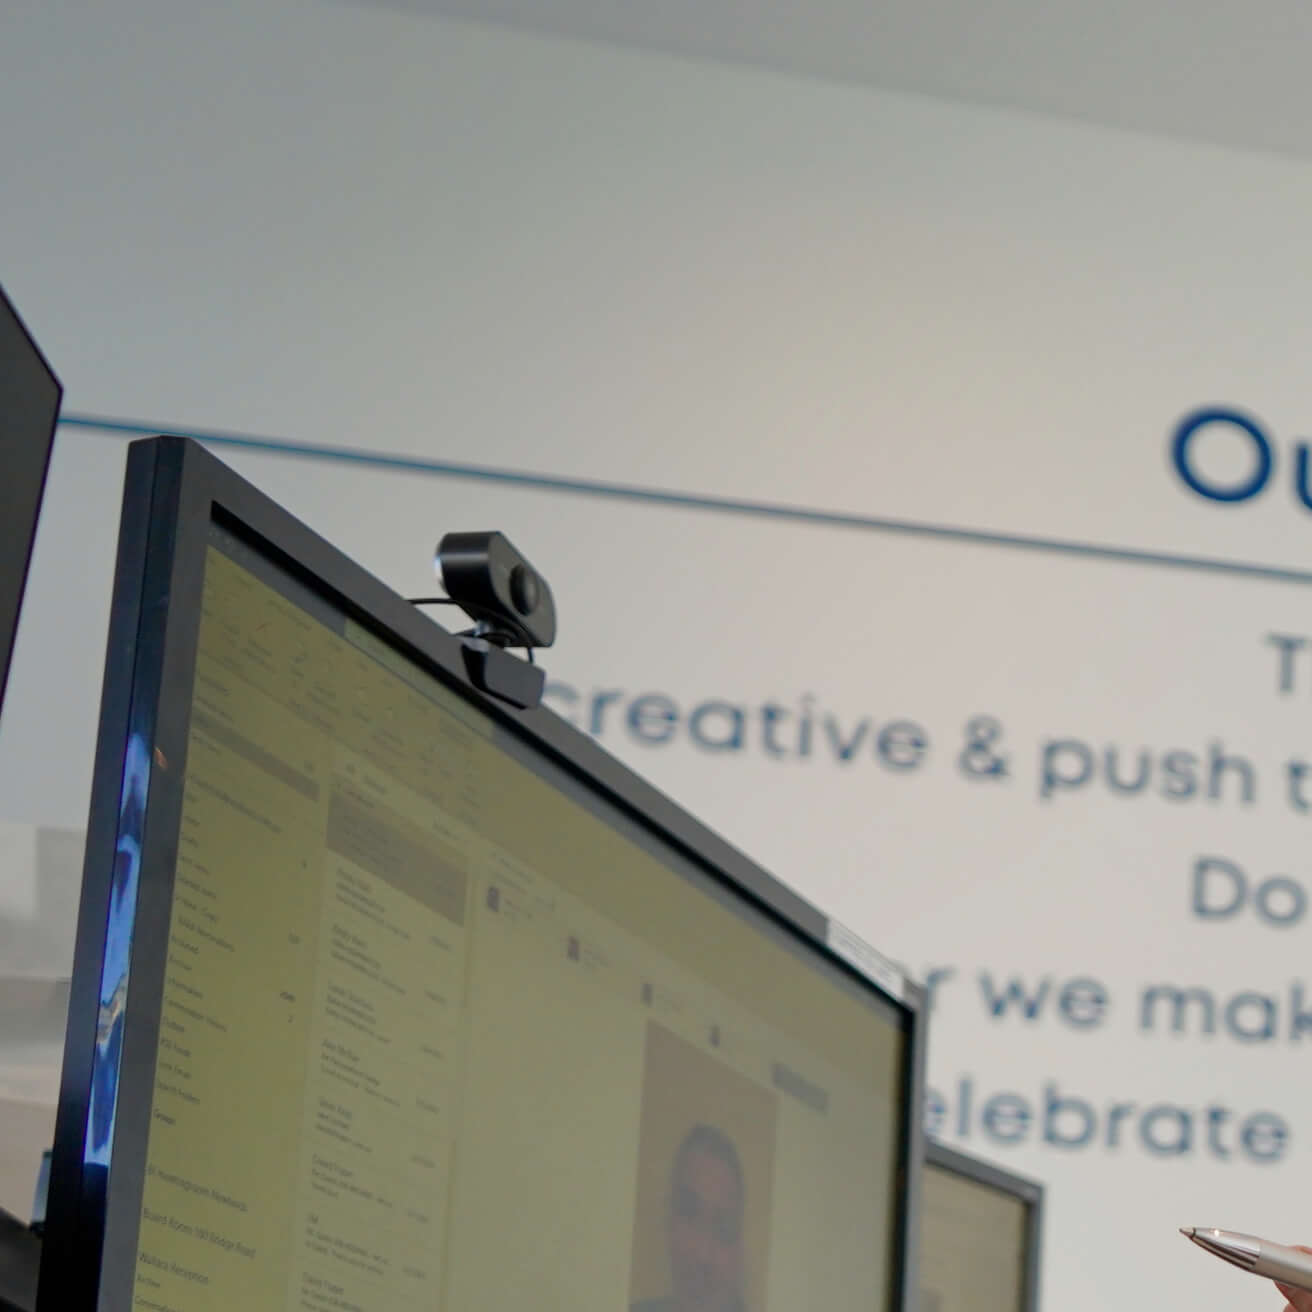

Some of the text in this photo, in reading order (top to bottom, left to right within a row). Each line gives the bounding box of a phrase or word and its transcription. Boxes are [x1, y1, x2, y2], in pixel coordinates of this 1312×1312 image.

[958, 715, 1012, 784] &
[1037, 734, 1256, 806] push
[1188, 853, 1306, 930] Do
[979, 966, 1109, 1032] we
[927, 1073, 1290, 1164] lebrate
